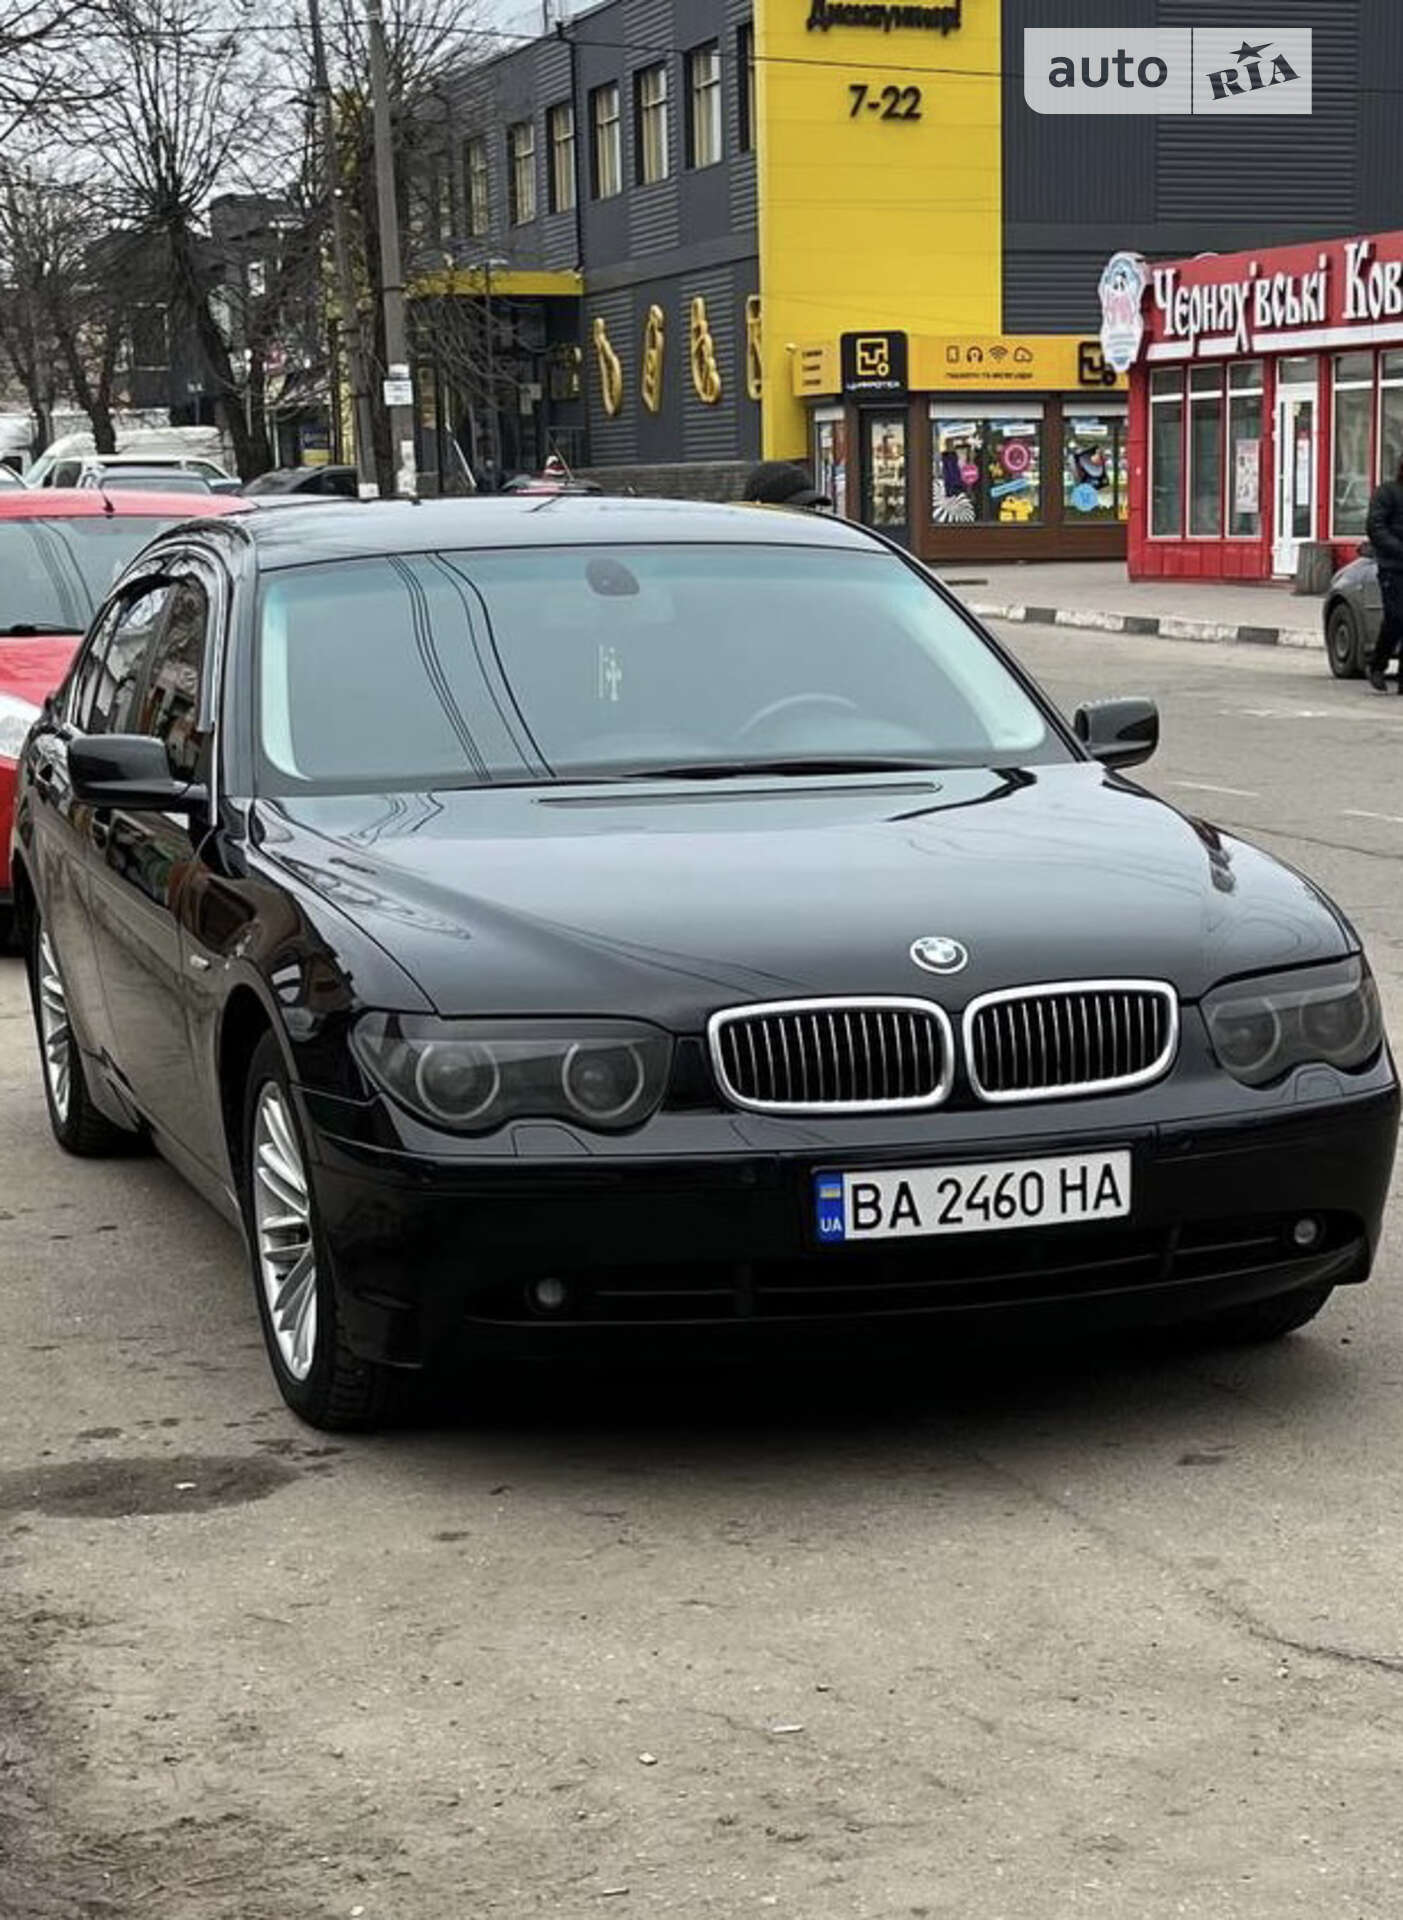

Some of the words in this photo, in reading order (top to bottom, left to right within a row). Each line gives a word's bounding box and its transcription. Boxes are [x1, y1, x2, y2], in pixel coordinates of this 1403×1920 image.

[848, 84, 922, 120] 7-22
[820, 1218, 843, 1232] UA
[852, 1181, 922, 1231] BA
[937, 1171, 1044, 1225] 2460
[1059, 1163, 1122, 1214] HA
